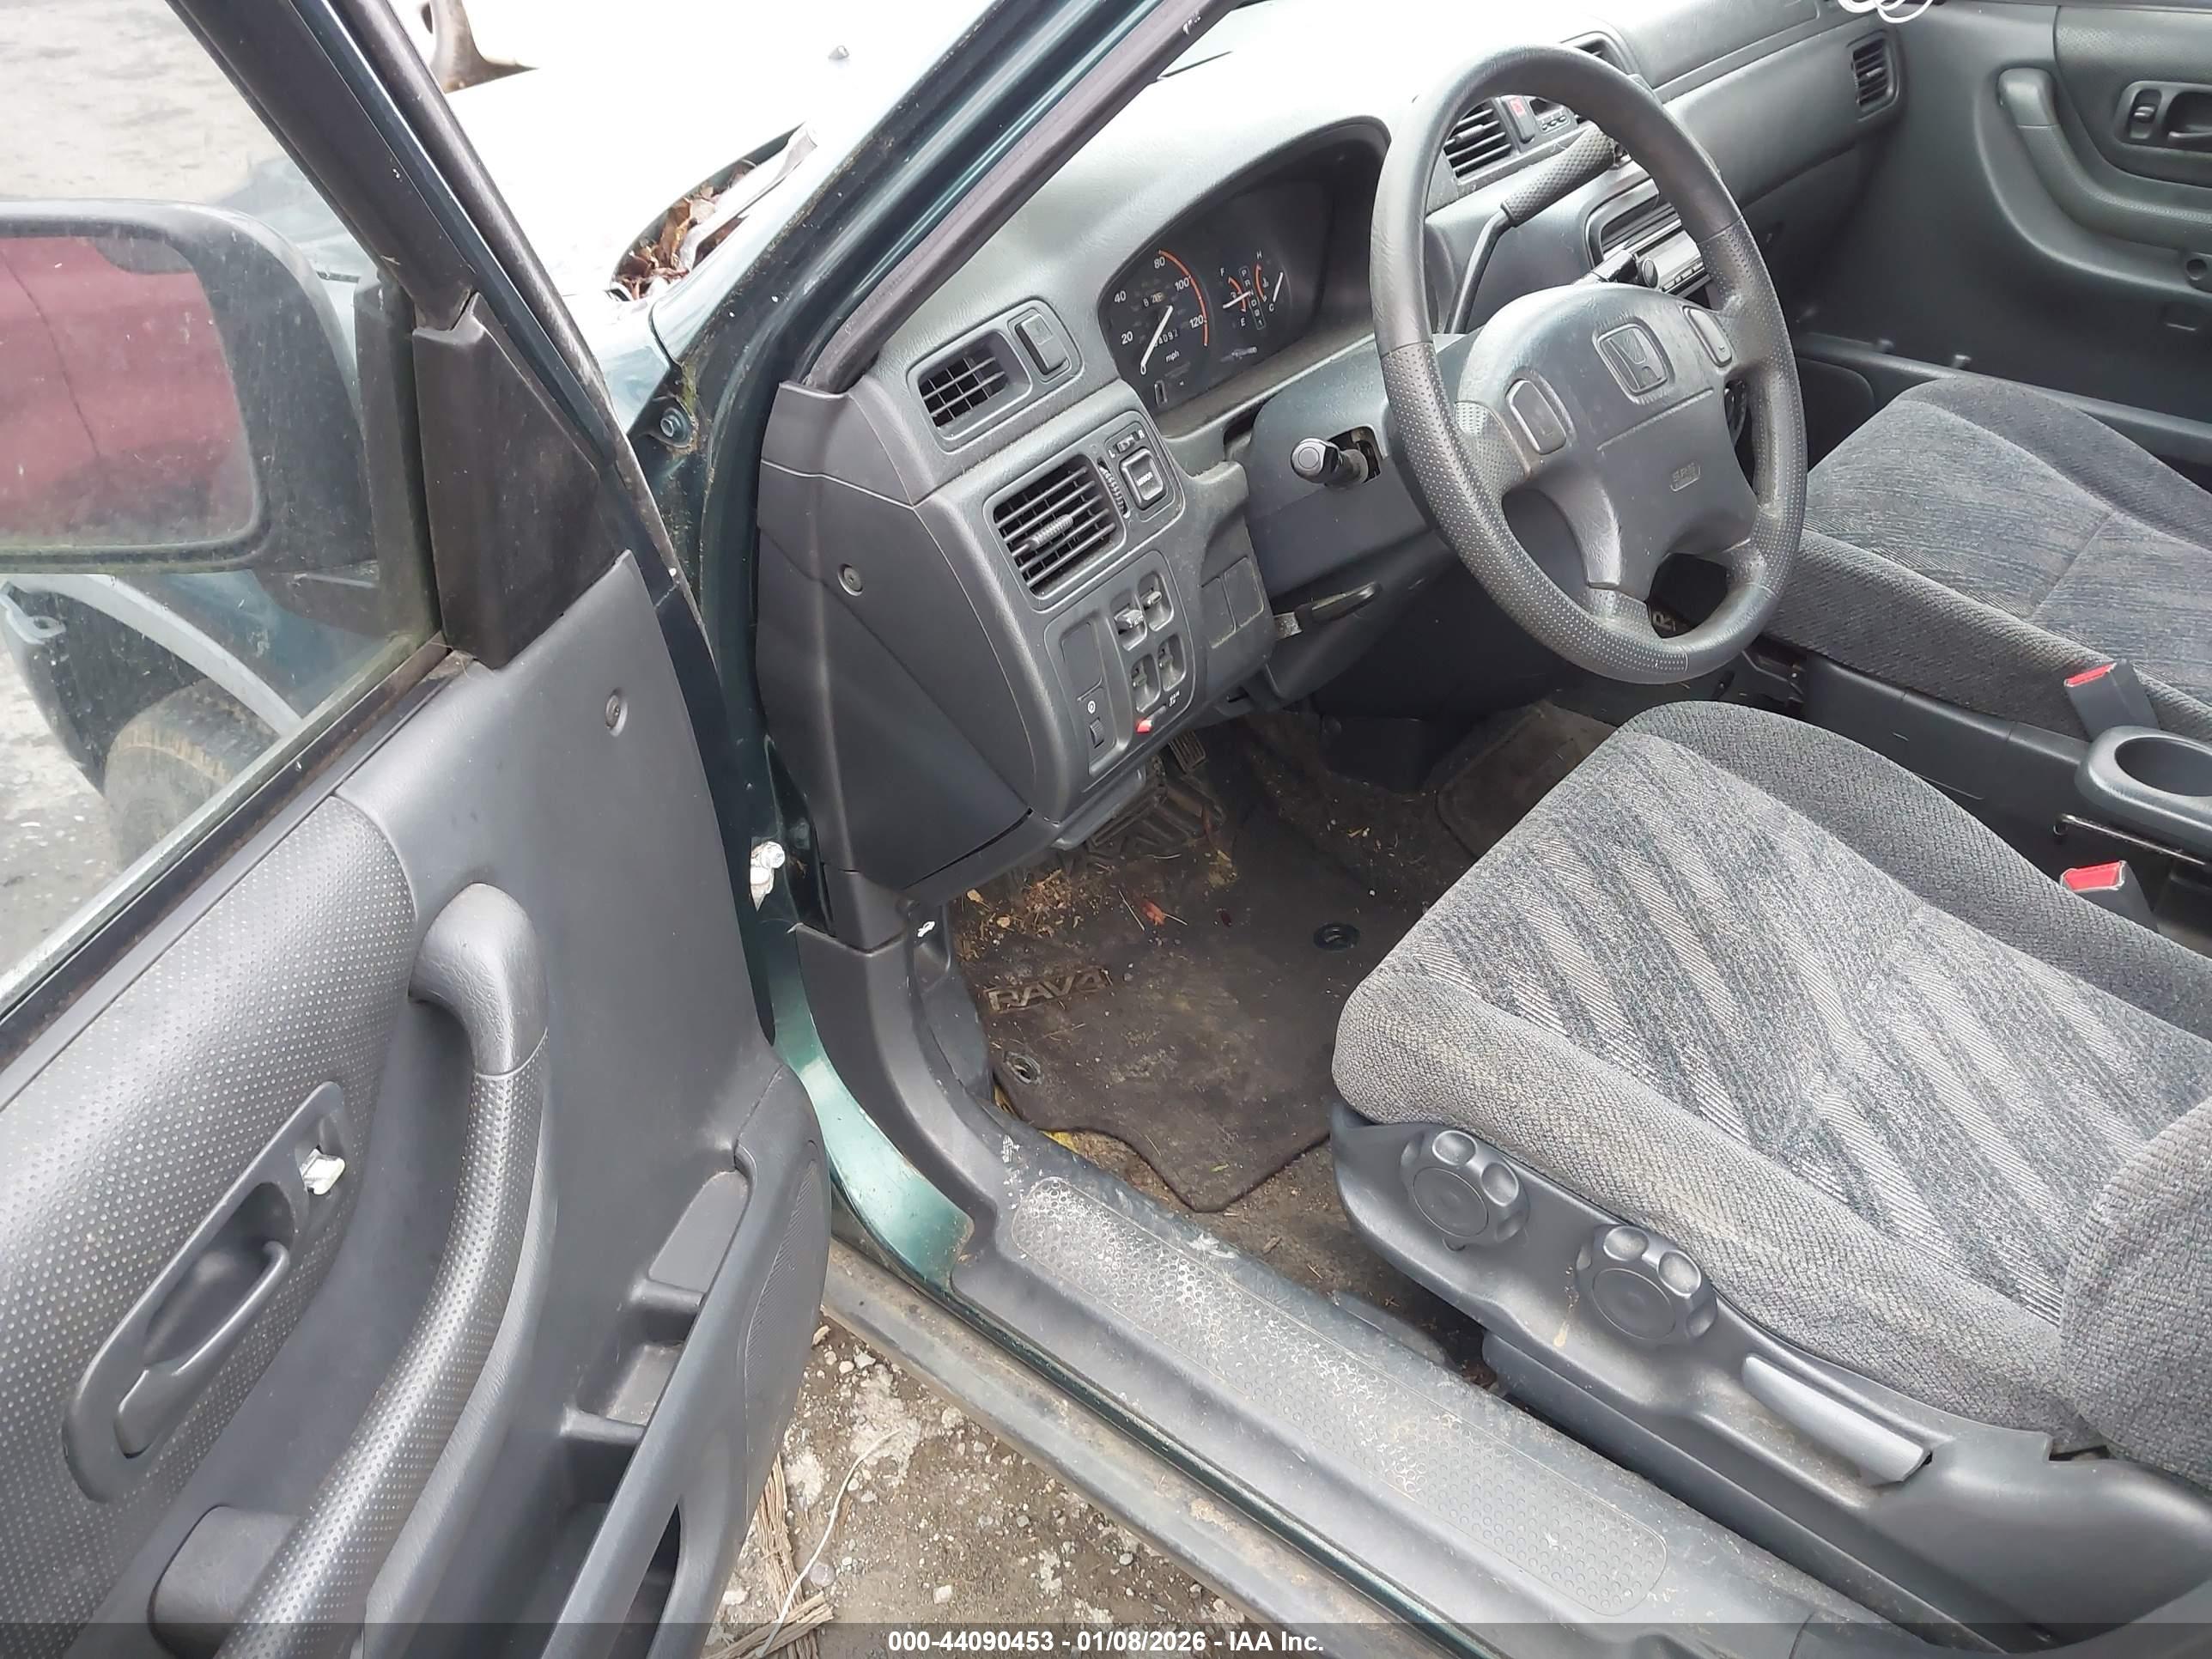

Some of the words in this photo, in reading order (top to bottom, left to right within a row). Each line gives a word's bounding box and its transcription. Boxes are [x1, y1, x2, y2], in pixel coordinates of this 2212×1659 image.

[1153, 256, 1165, 269] 80
[1174, 276, 1190, 293] 100
[1114, 289, 1127, 303] 40
[1189, 314, 1205, 329] 120
[1121, 331, 1133, 345] 20
[1165, 349, 1180, 363] mph
[1139, 364, 1147, 376] 0
